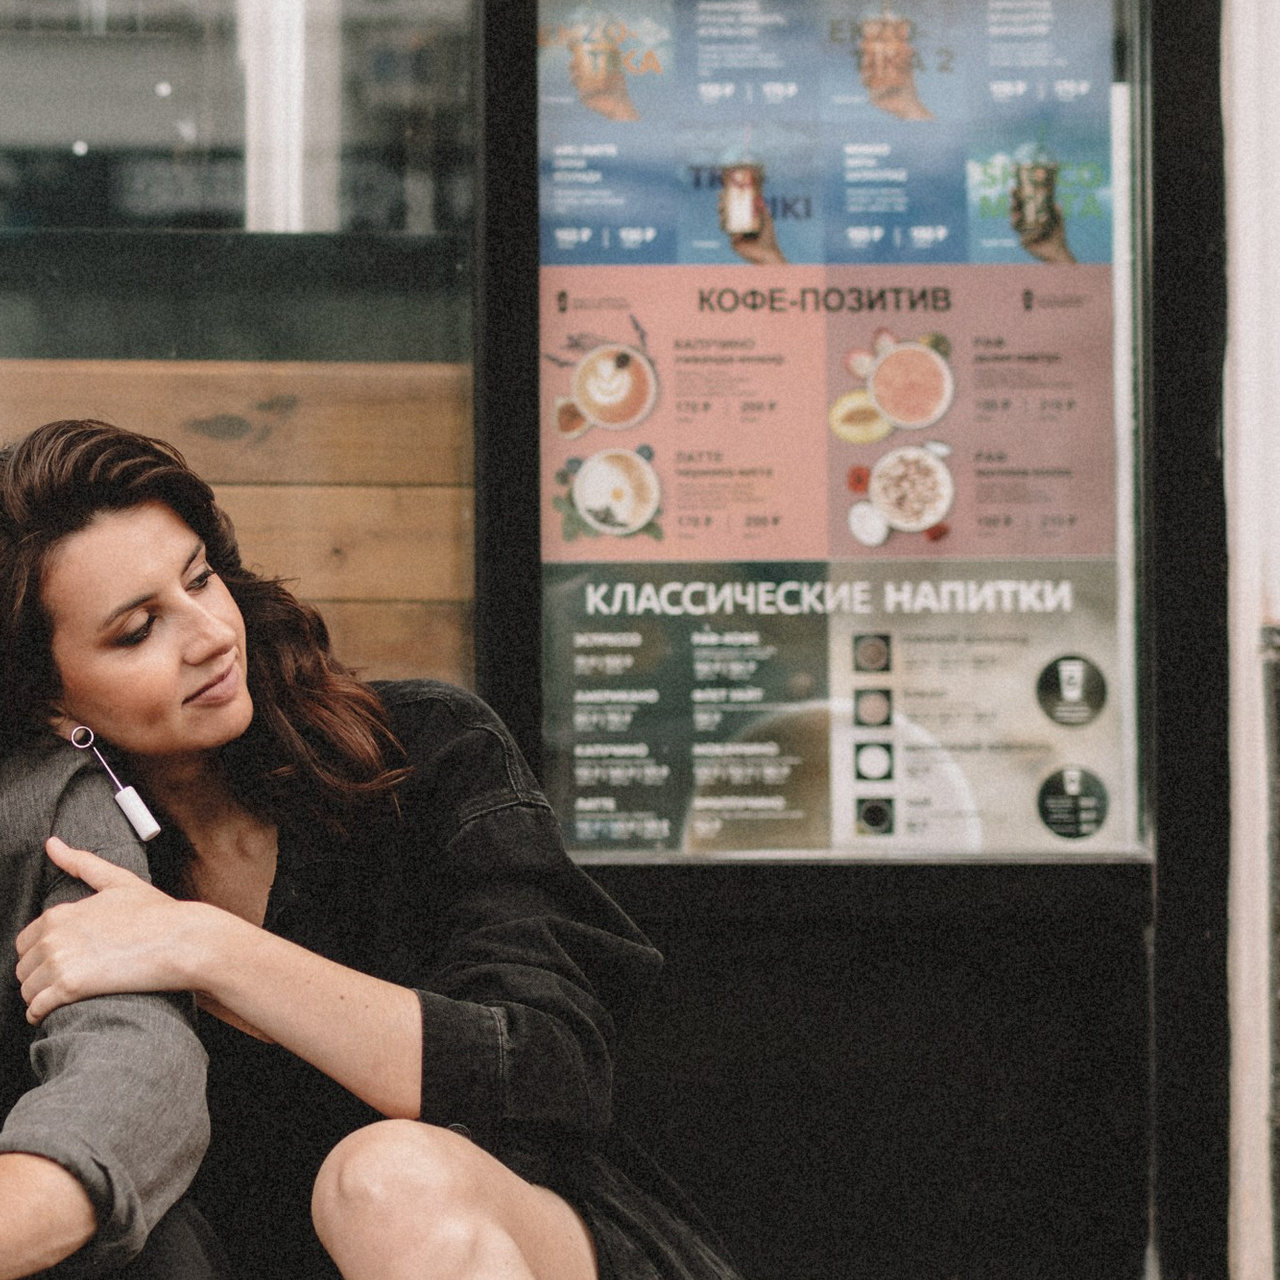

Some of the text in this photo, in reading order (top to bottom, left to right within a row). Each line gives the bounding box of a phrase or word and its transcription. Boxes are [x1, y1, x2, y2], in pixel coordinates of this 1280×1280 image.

[936, 48, 956, 73] 2
[697, 286, 952, 313] КОФЕ-ПОЗИТИВ
[585, 580, 1074, 616] КЛАССИЧЕСКИЕ НАПИТКИ
